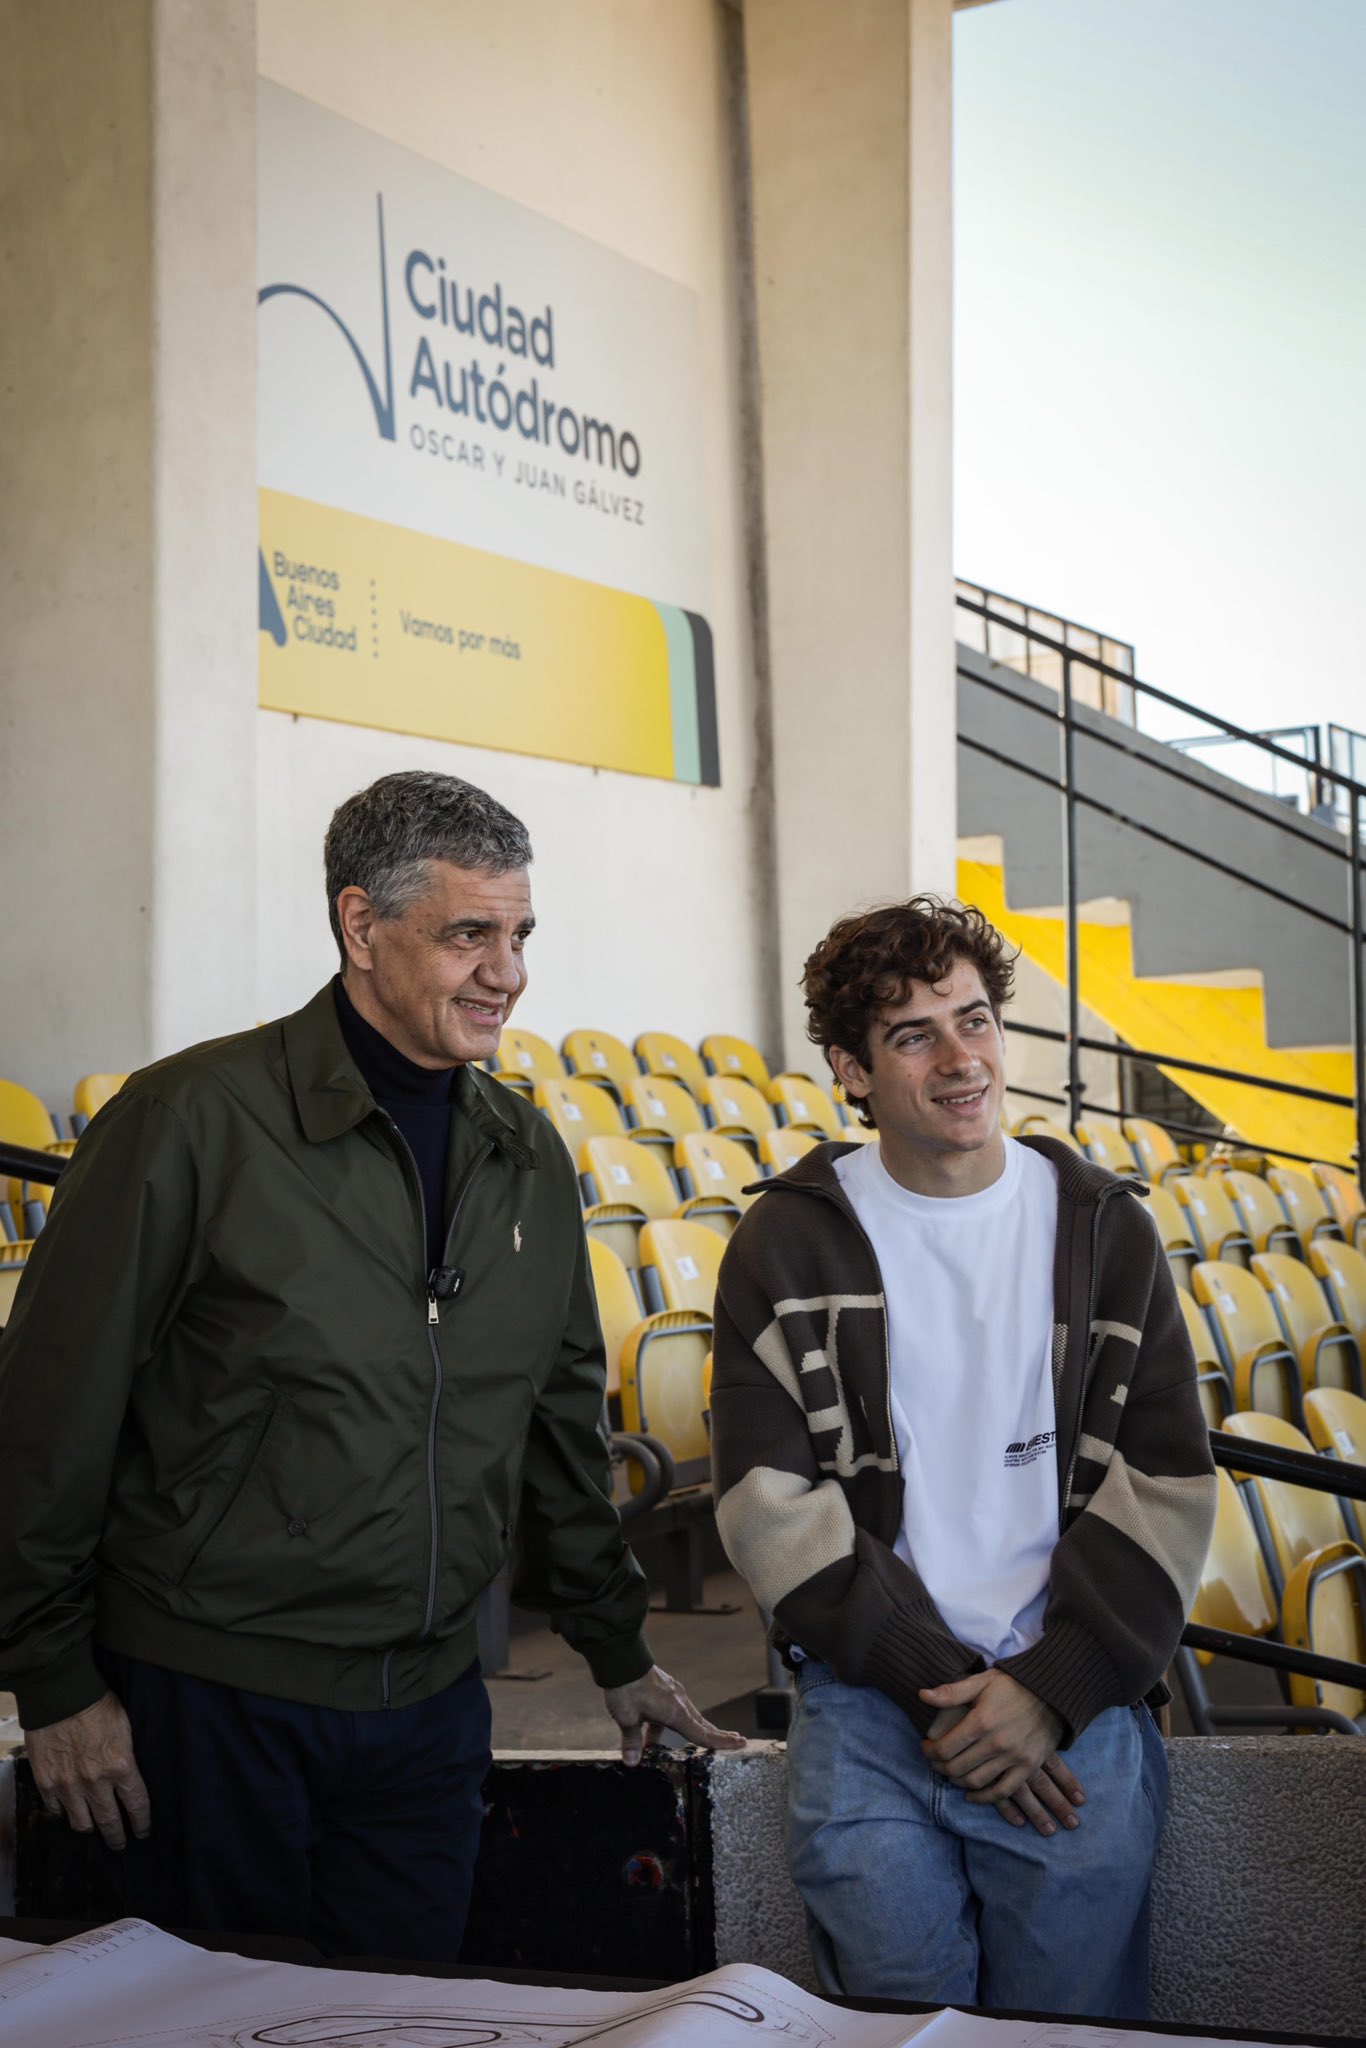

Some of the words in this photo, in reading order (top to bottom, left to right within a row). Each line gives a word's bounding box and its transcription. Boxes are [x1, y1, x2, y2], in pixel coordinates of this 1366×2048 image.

[404, 249, 555, 369] Ciudad
[409, 336, 641, 478] Autódromo
[409, 424, 485, 472] OSCAR
[491, 451, 506, 478] Y
[514, 460, 567, 498] JUAN
[573, 479, 645, 526] GÁLVEZ
[273, 551, 340, 591] Buenos
[287, 584, 336, 619] Aires
[293, 614, 358, 652] Ciudad
[399, 608, 454, 646] Vamos
[458, 629, 486, 655] por
[489, 633, 522, 661] más
